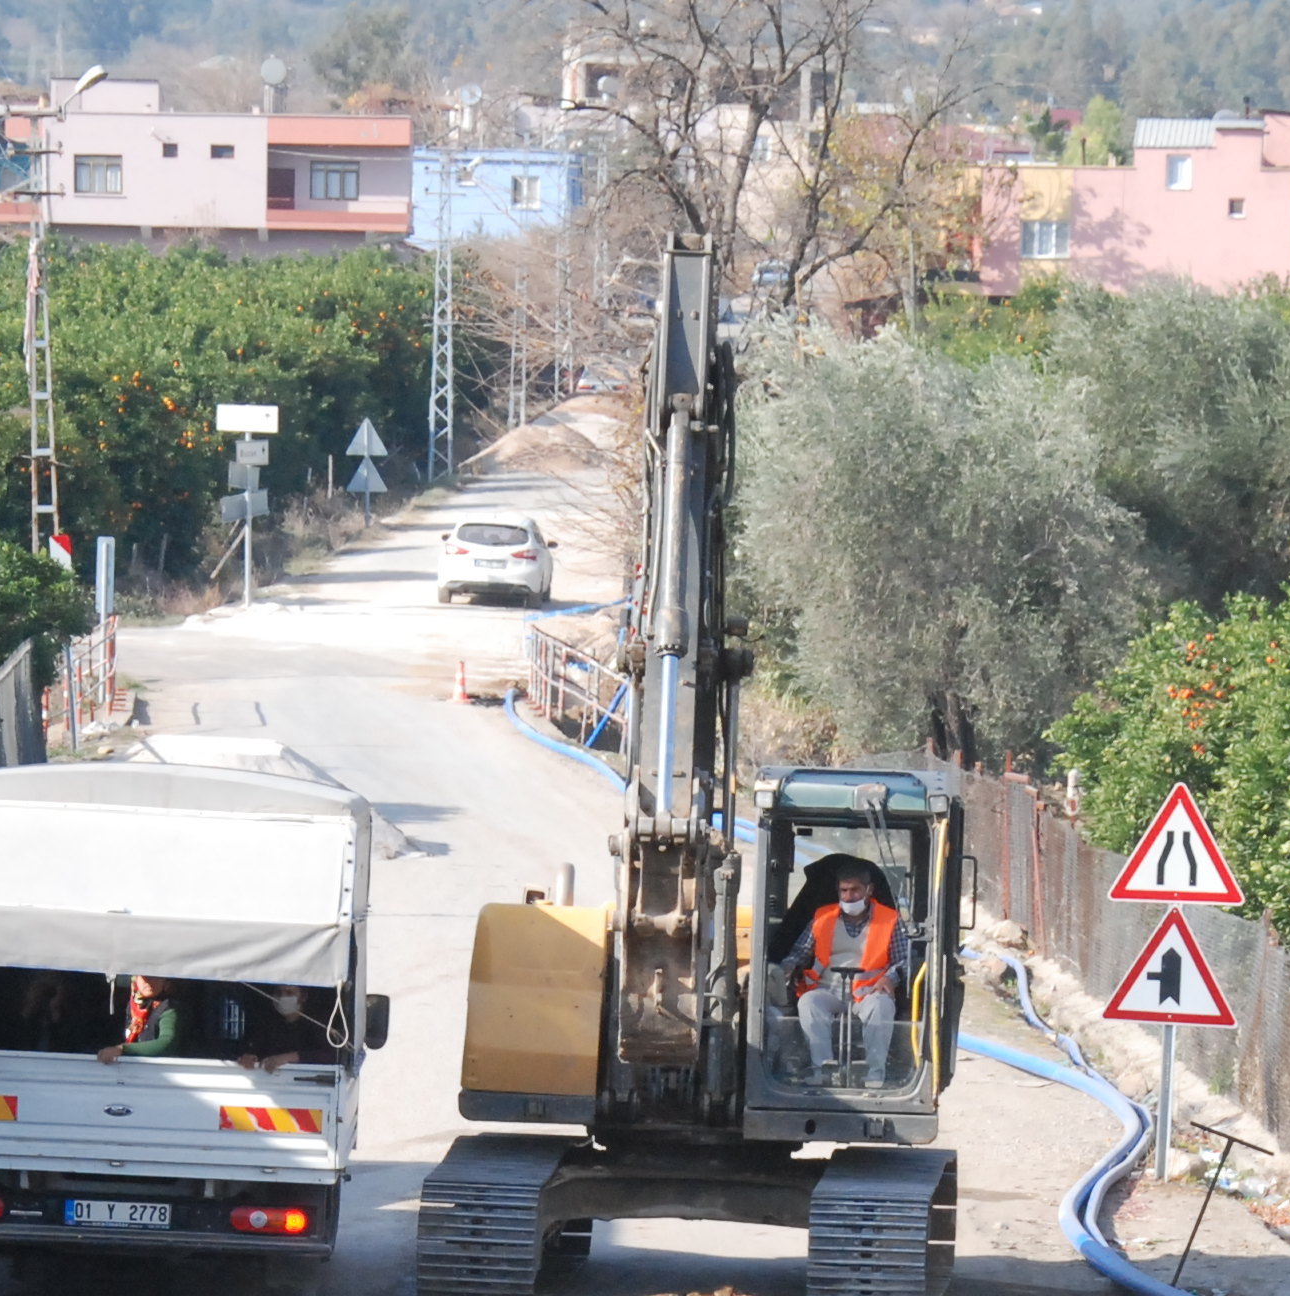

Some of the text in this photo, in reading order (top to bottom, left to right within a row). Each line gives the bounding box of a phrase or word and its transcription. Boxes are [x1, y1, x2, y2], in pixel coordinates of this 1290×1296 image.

[74, 1202, 91, 1219] 01
[107, 1203, 116, 1220] Y
[129, 1205, 168, 1223] 2778
